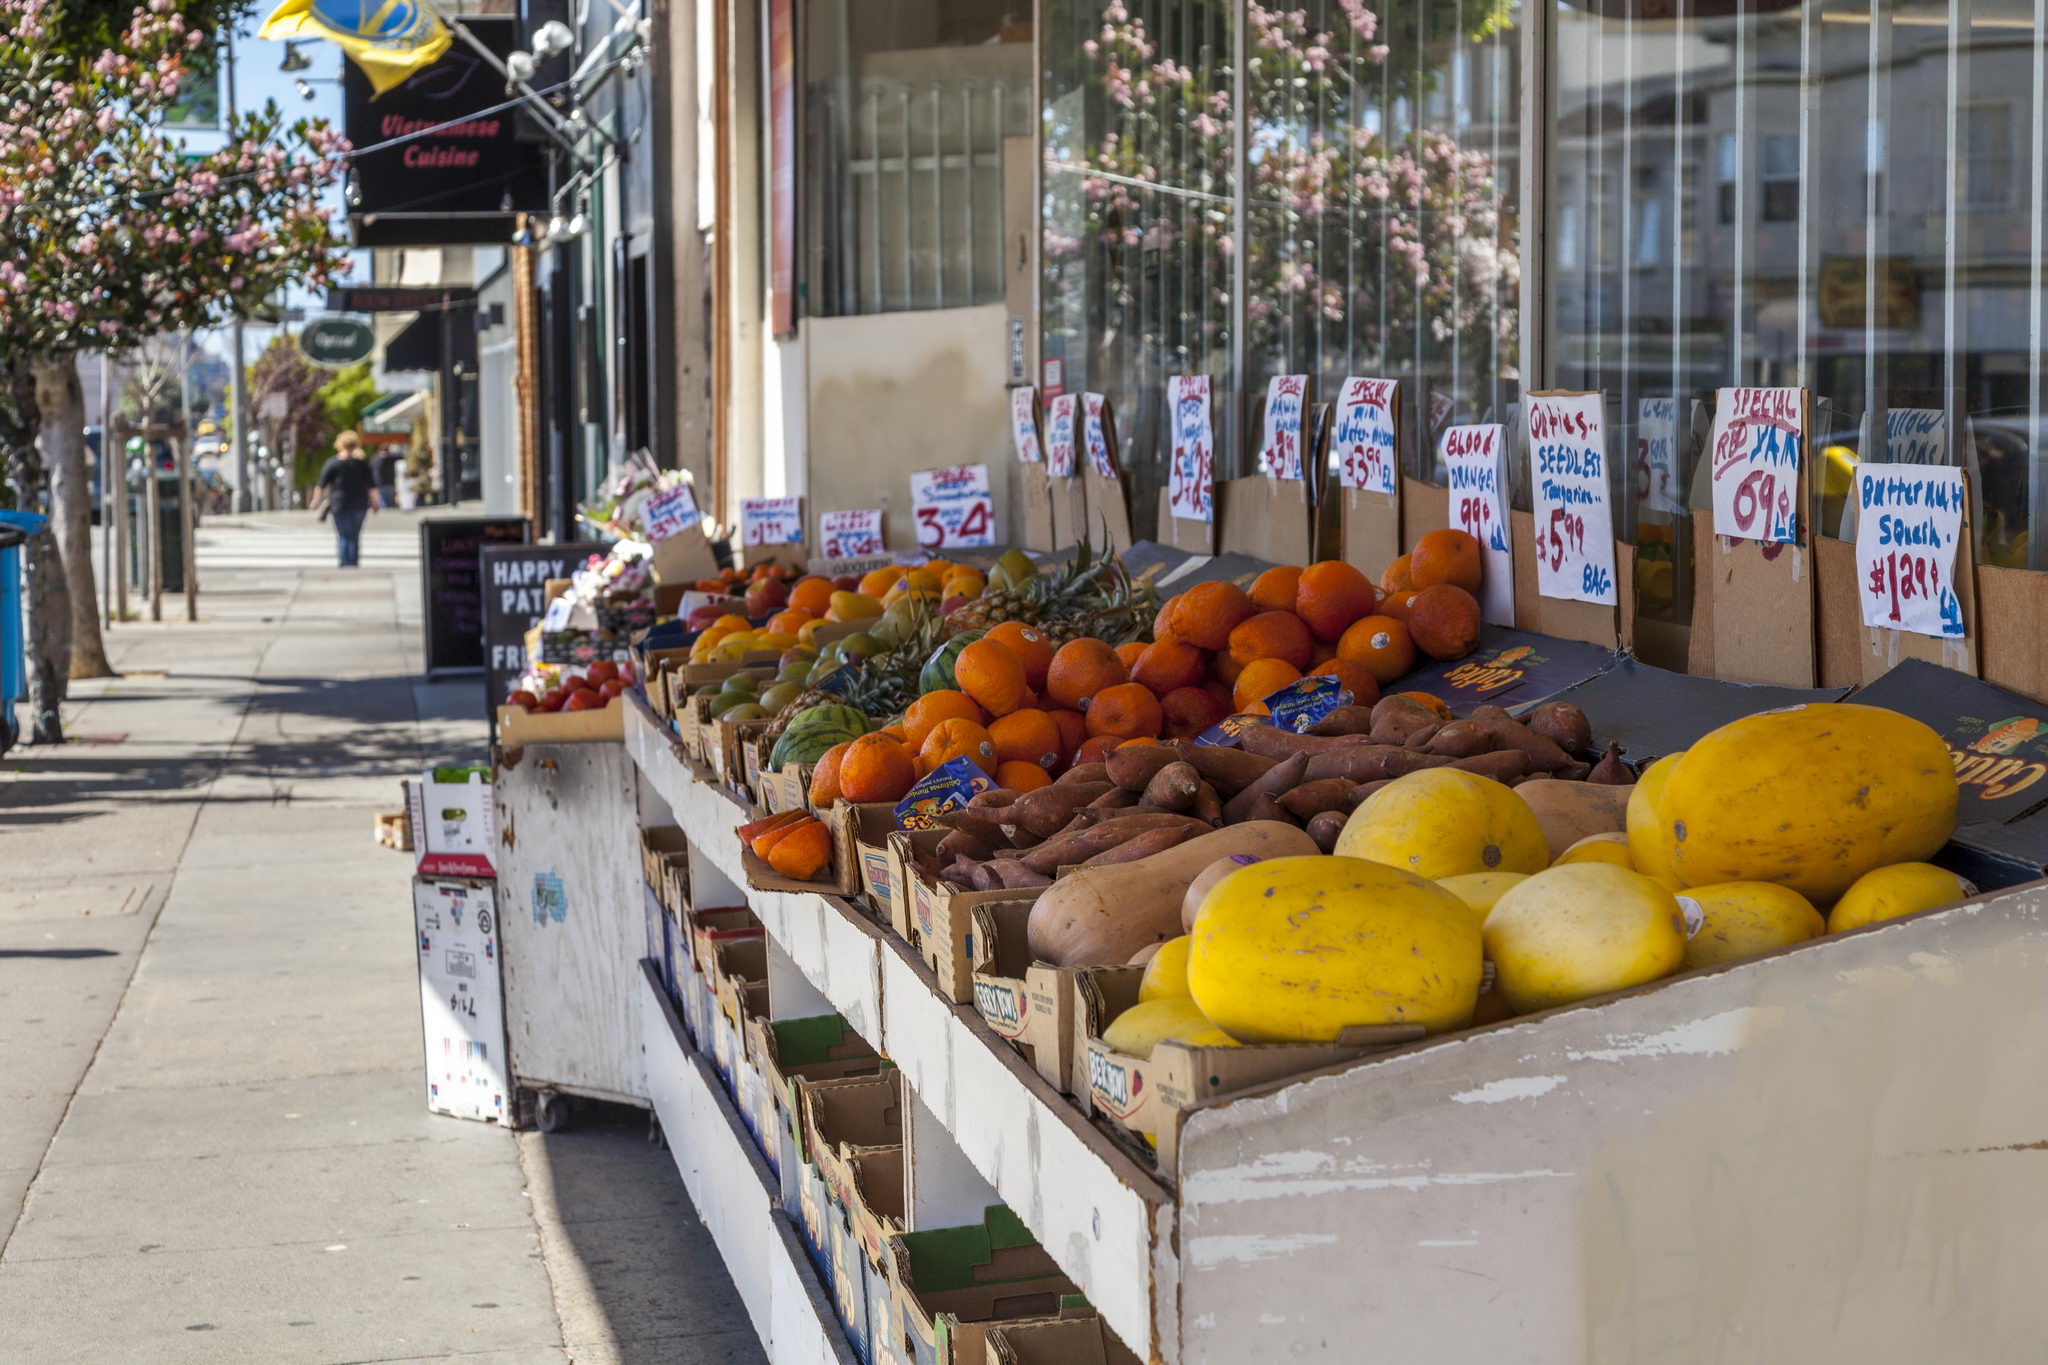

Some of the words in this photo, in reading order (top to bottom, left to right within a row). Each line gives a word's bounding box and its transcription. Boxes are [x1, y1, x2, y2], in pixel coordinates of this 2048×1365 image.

[381, 114, 500, 137] Vietnamese
[403, 144, 479, 167] Cuisine
[1350, 380, 1390, 401] SPECIAL
[1733, 388, 1797, 419] SPECIAL
[493, 560, 565, 587] HAPPY
[1582, 561, 1612, 597] BAG
